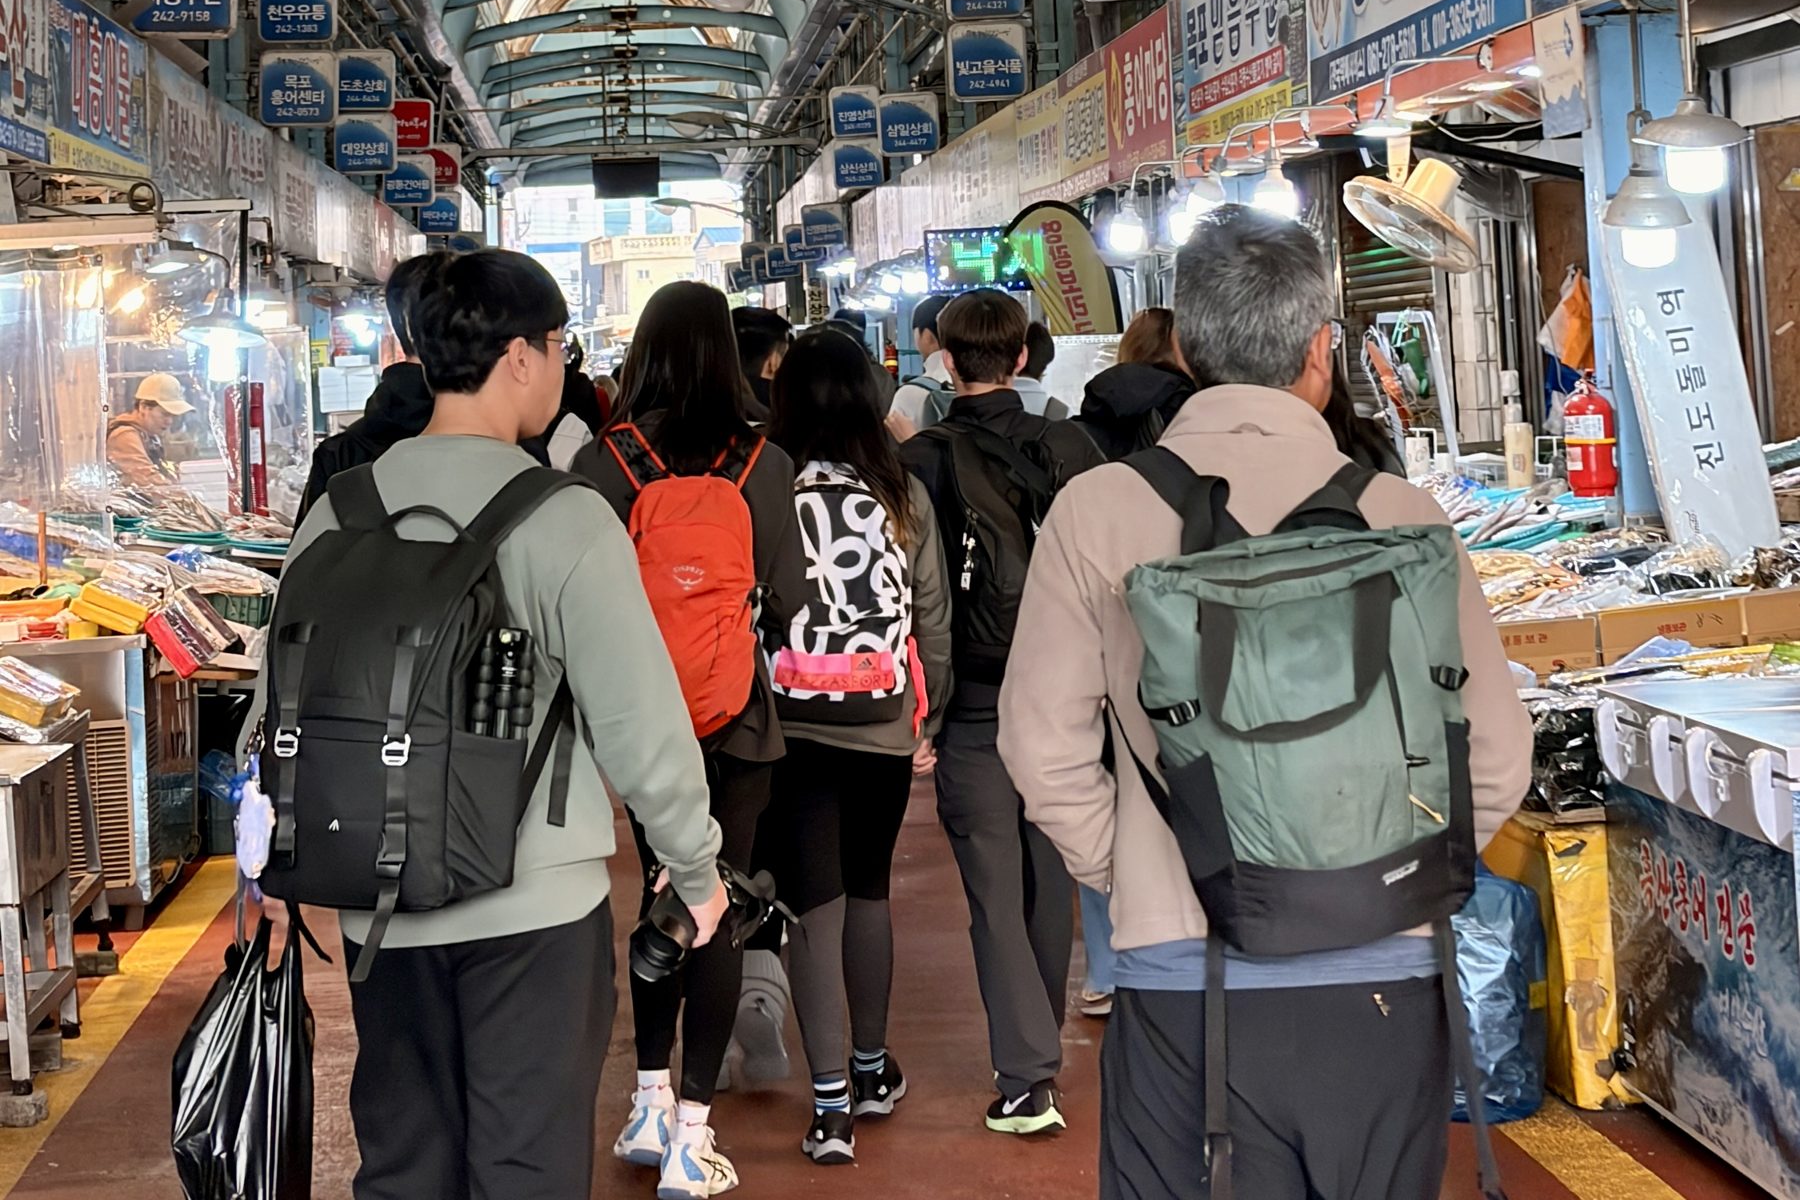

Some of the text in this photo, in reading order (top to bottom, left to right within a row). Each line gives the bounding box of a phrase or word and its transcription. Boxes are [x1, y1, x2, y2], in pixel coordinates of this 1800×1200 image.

[267, 4, 327, 21] 천우유통
[966, 1, 1008, 11] 244-4321
[152, 11, 211, 23] 242-9158
[956, 59, 1023, 76] 빛고을식품
[284, 74, 312, 88] 목포
[339, 79, 387, 93] 도초상회
[1123, 32, 1168, 137] 홍어마당
[887, 122, 933, 137] 삼일상회
[341, 142, 389, 156] 대양상회
[1715, 879, 1757, 971] 전문
